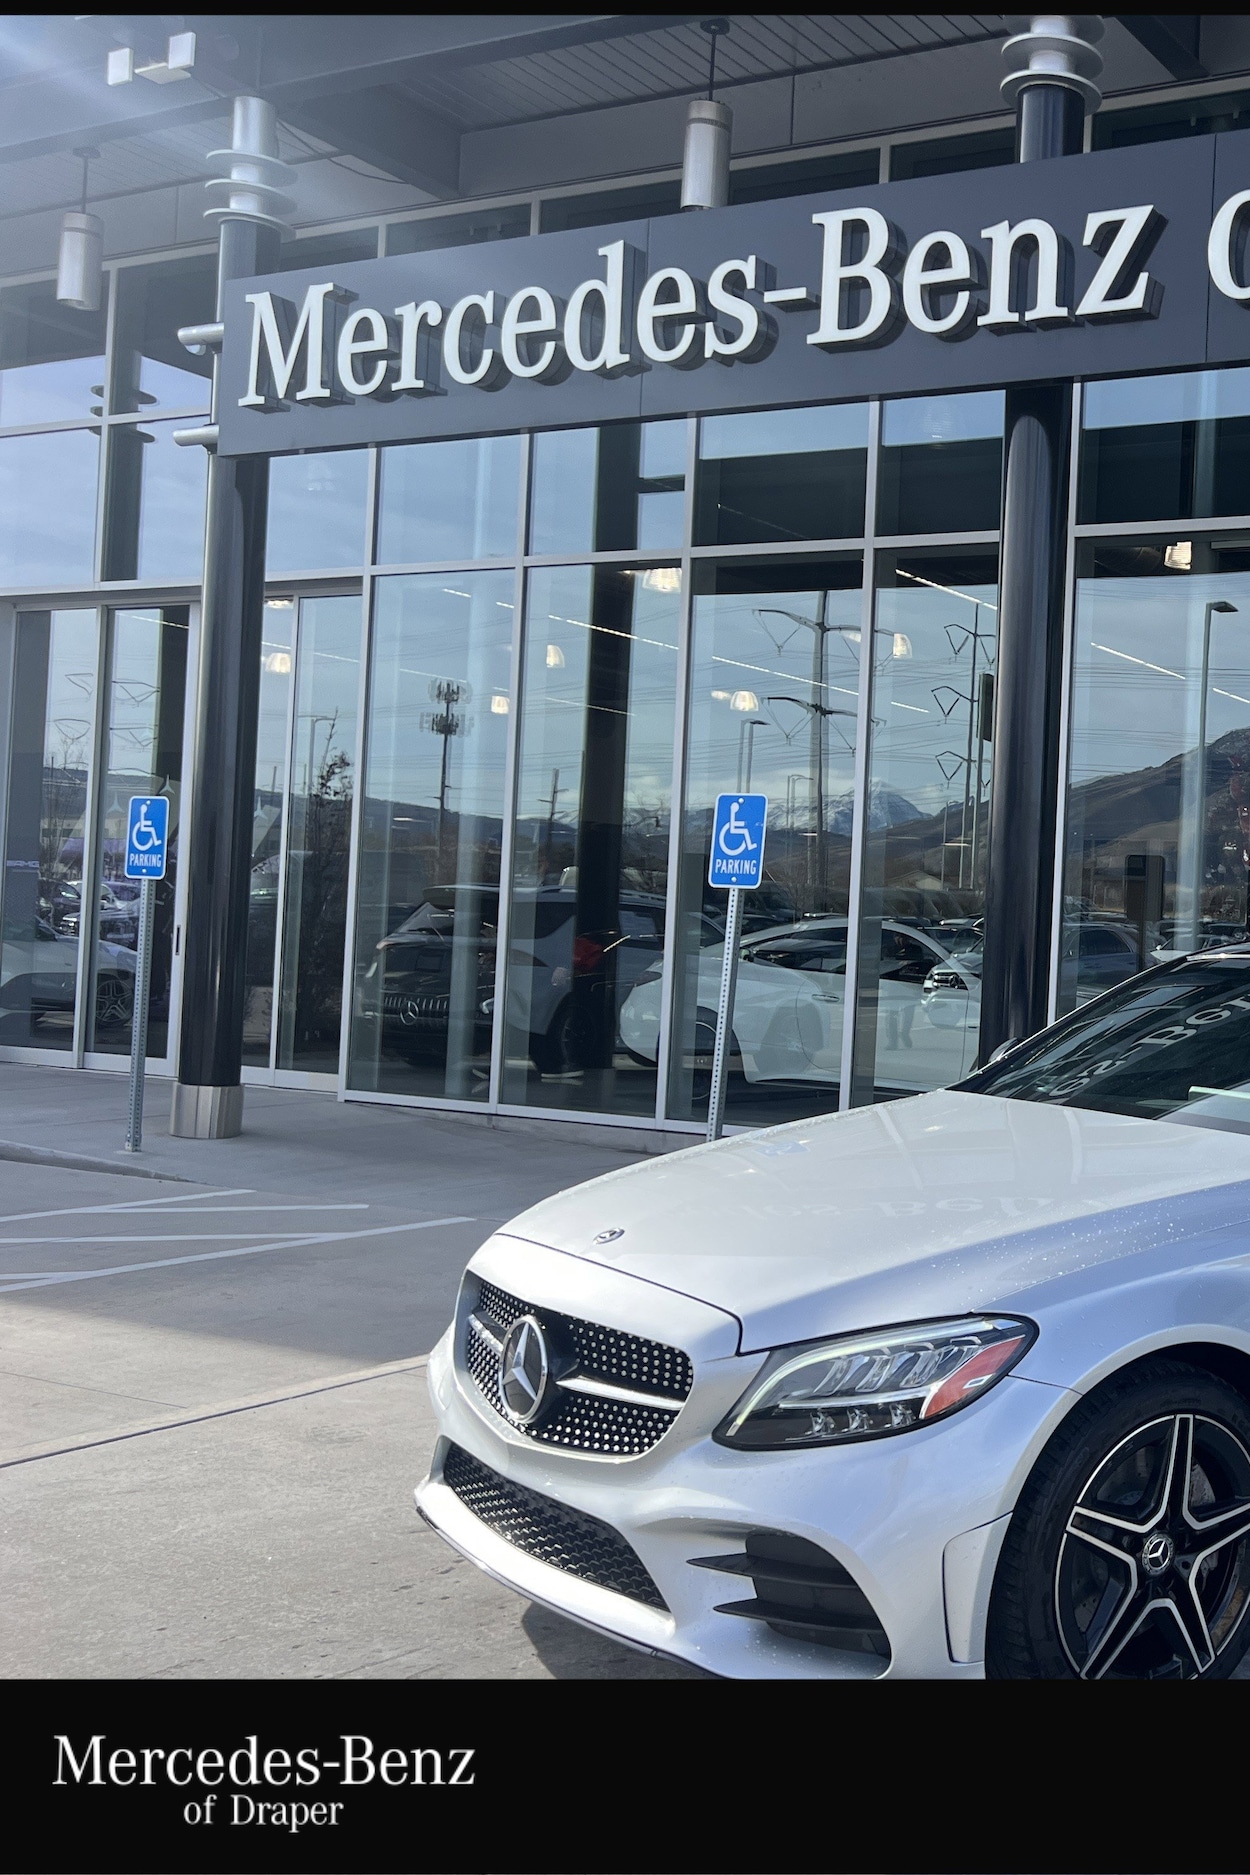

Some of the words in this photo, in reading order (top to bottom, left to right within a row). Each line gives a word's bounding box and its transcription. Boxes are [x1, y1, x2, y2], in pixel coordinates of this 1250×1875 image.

[238, 203, 1155, 408] Mercedes-Benz
[129, 853, 162, 867] PARKING
[714, 858, 757, 875] PARKING
